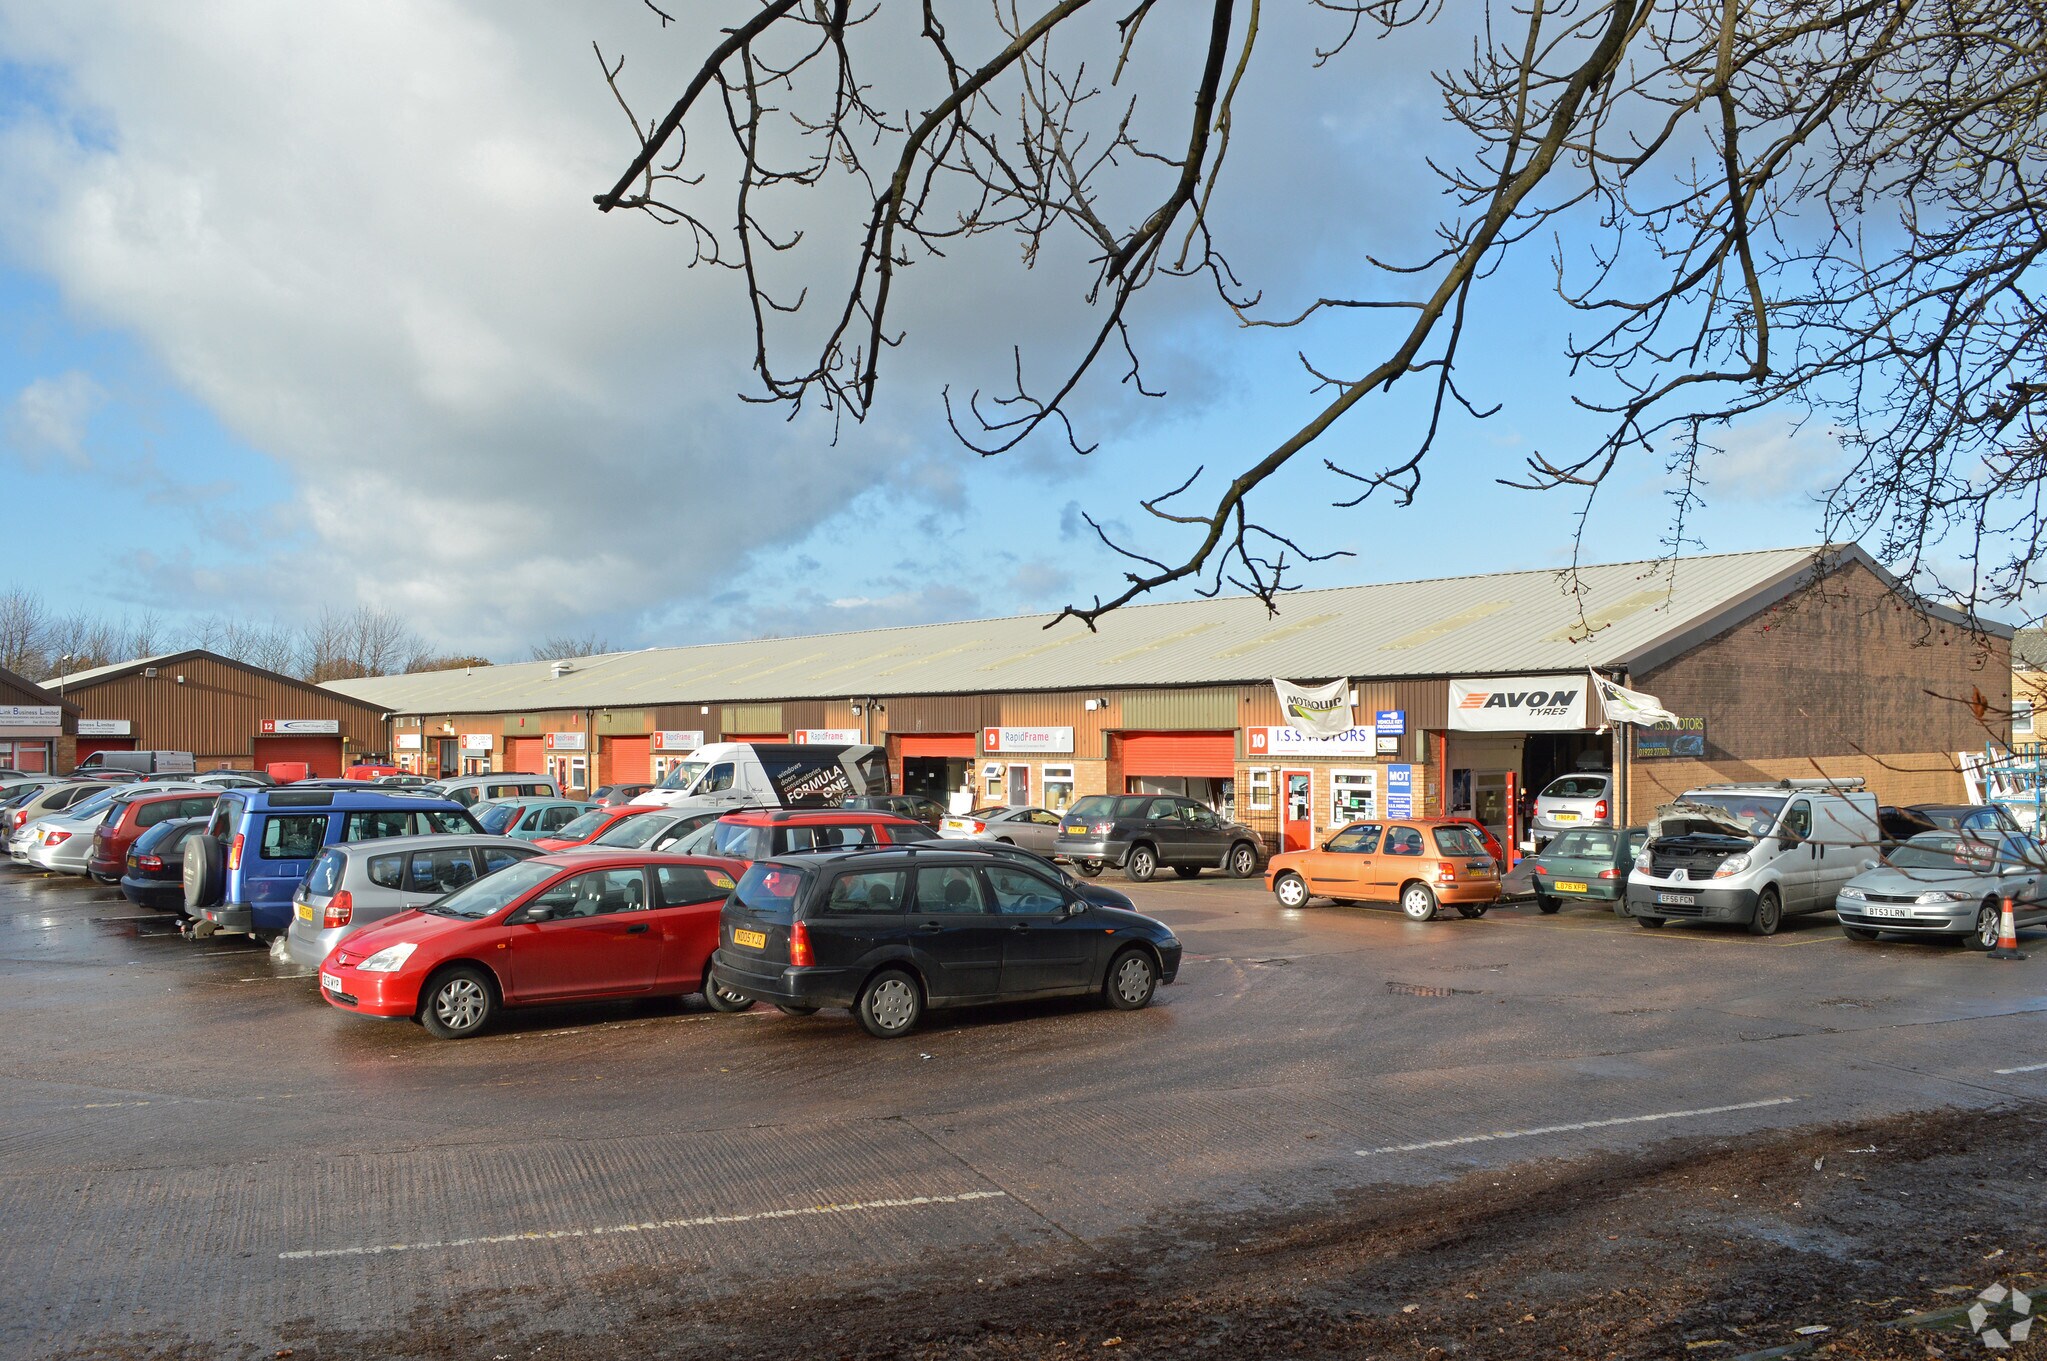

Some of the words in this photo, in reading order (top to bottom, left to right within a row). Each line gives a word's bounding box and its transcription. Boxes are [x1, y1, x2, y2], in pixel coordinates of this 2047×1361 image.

[1287, 696, 1342, 710] MOTAQUIP
[1484, 690, 1578, 708] AVON
[13, 707, 38, 716] Business
[40, 708, 60, 716] Limited
[1529, 707, 1567, 716] TYRES
[548, 737, 553, 745] 6
[656, 736, 661, 745] 7
[811, 732, 844, 741] RapidFrame
[989, 733, 996, 746] 9
[1005, 732, 1049, 743] RapidFrame
[1252, 734, 1265, 748] 10
[777, 762, 802, 779] windows
[1389, 771, 1410, 781] MOT
[780, 774, 797, 786] doors
[783, 767, 822, 792] conservatories
[786, 765, 843, 804] FORMULA
[822, 776, 849, 799] ONE
[1869, 907, 1889, 917] BT53
[1890, 909, 1906, 917] LRN
